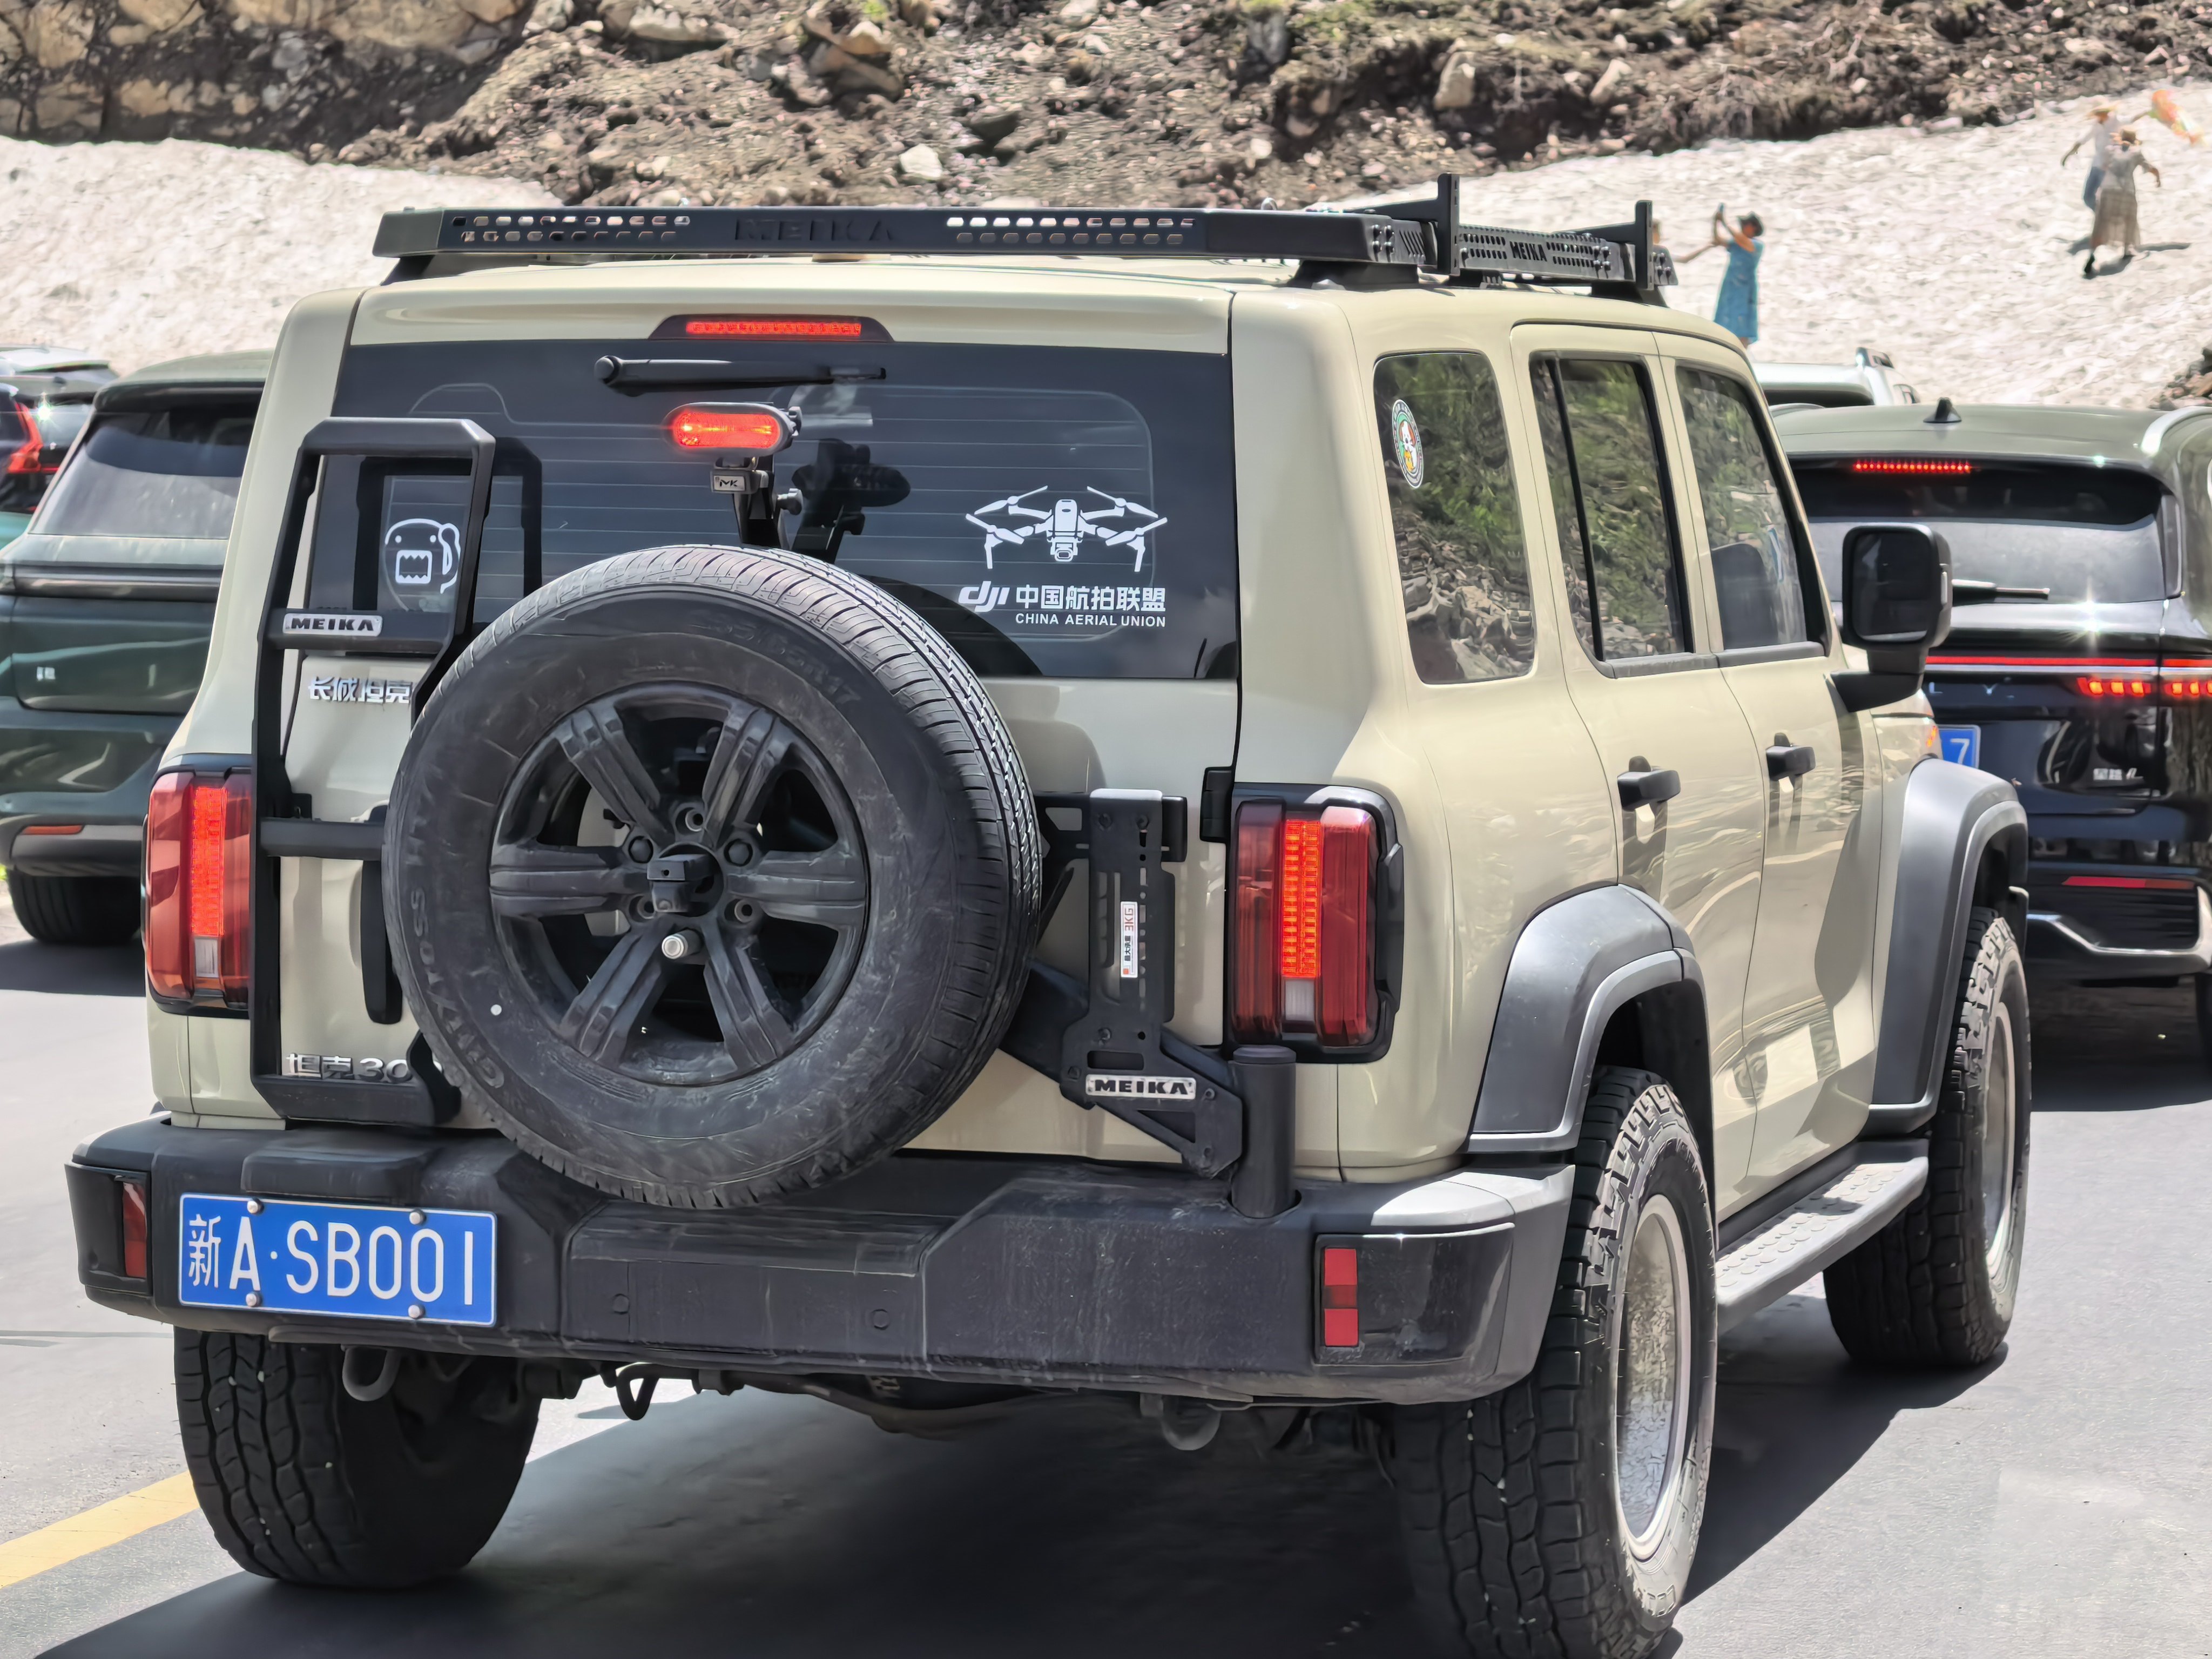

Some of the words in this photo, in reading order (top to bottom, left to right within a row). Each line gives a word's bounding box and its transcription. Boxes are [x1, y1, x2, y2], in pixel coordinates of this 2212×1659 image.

[1509, 241, 1548, 262] MEIKA
[1016, 584, 1166, 612] 中国航拍联盟
[291, 618, 374, 631] MEIKA
[1015, 613, 1059, 624] CHINA
[1065, 614, 1117, 625] AERIAL
[1121, 615, 1165, 627] UNION
[1095, 1080, 1188, 1095] MEIKA
[189, 1213, 473, 1305] 新A·SB001
